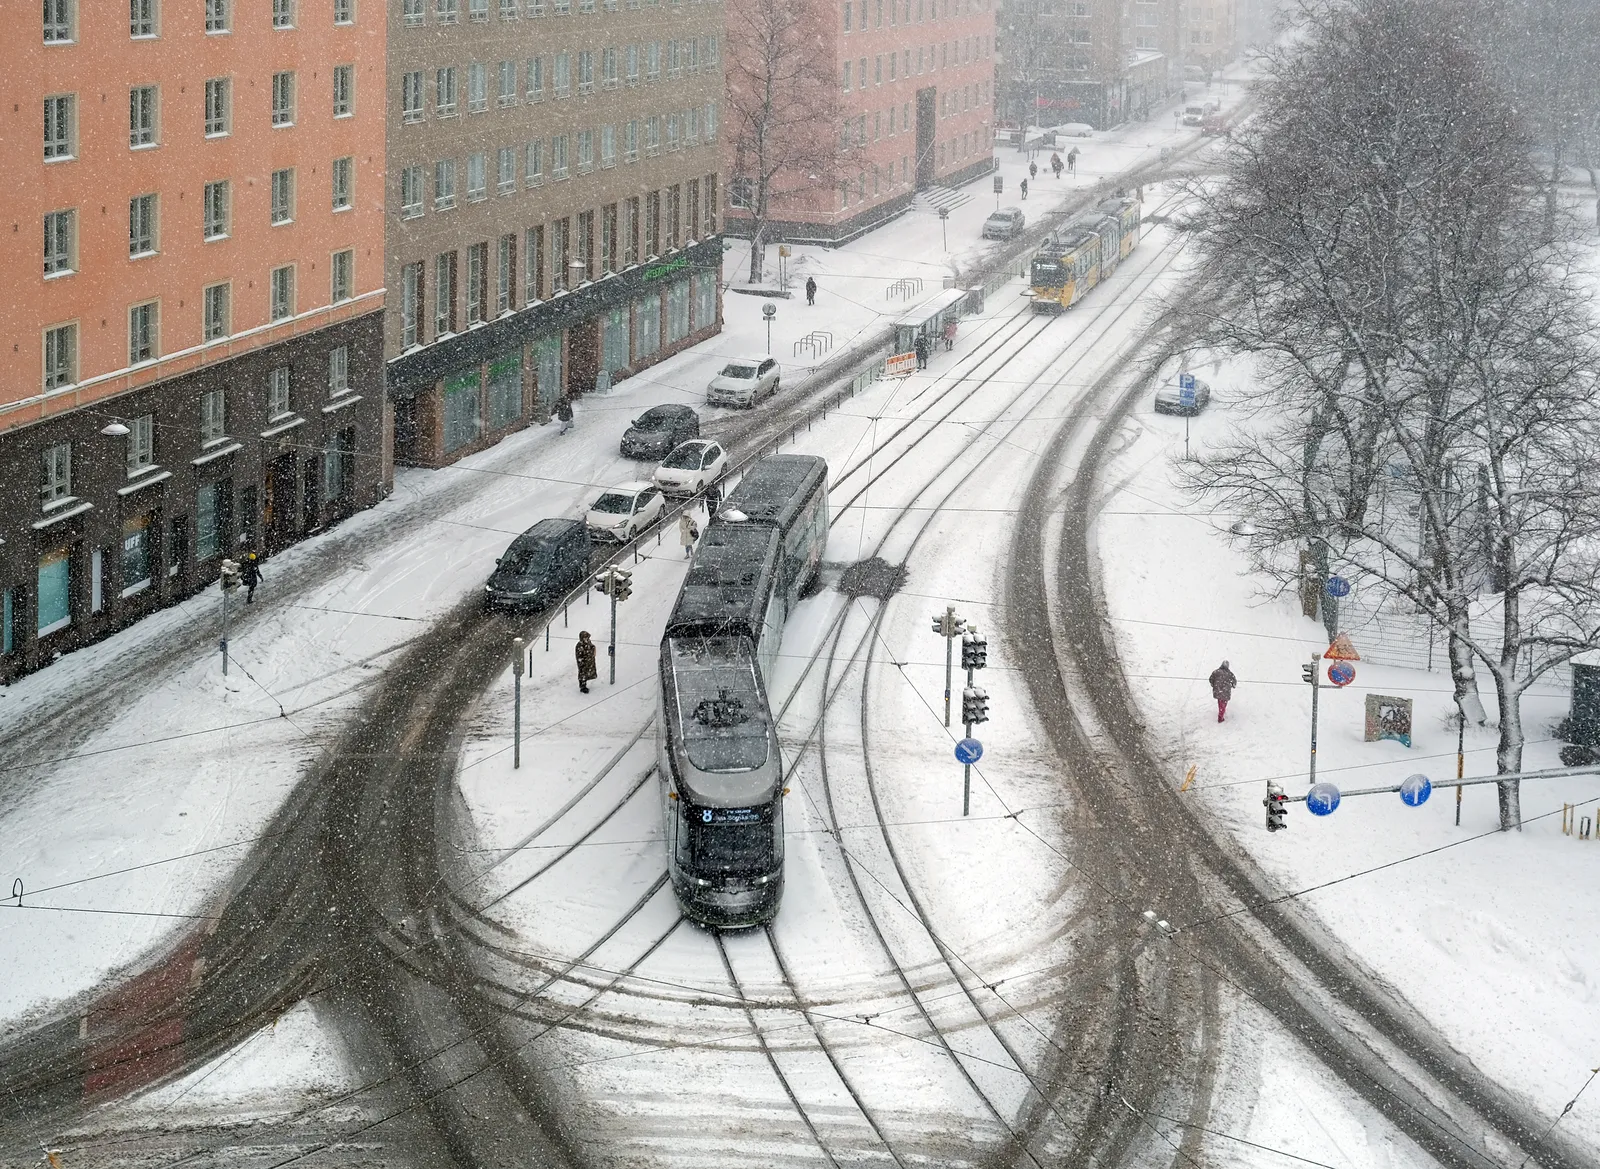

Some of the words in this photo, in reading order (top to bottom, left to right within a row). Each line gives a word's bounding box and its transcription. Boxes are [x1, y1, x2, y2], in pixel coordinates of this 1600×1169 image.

[1183, 376, 1193, 388] P
[125, 534, 142, 550] UFF
[702, 809, 712, 822] 8
